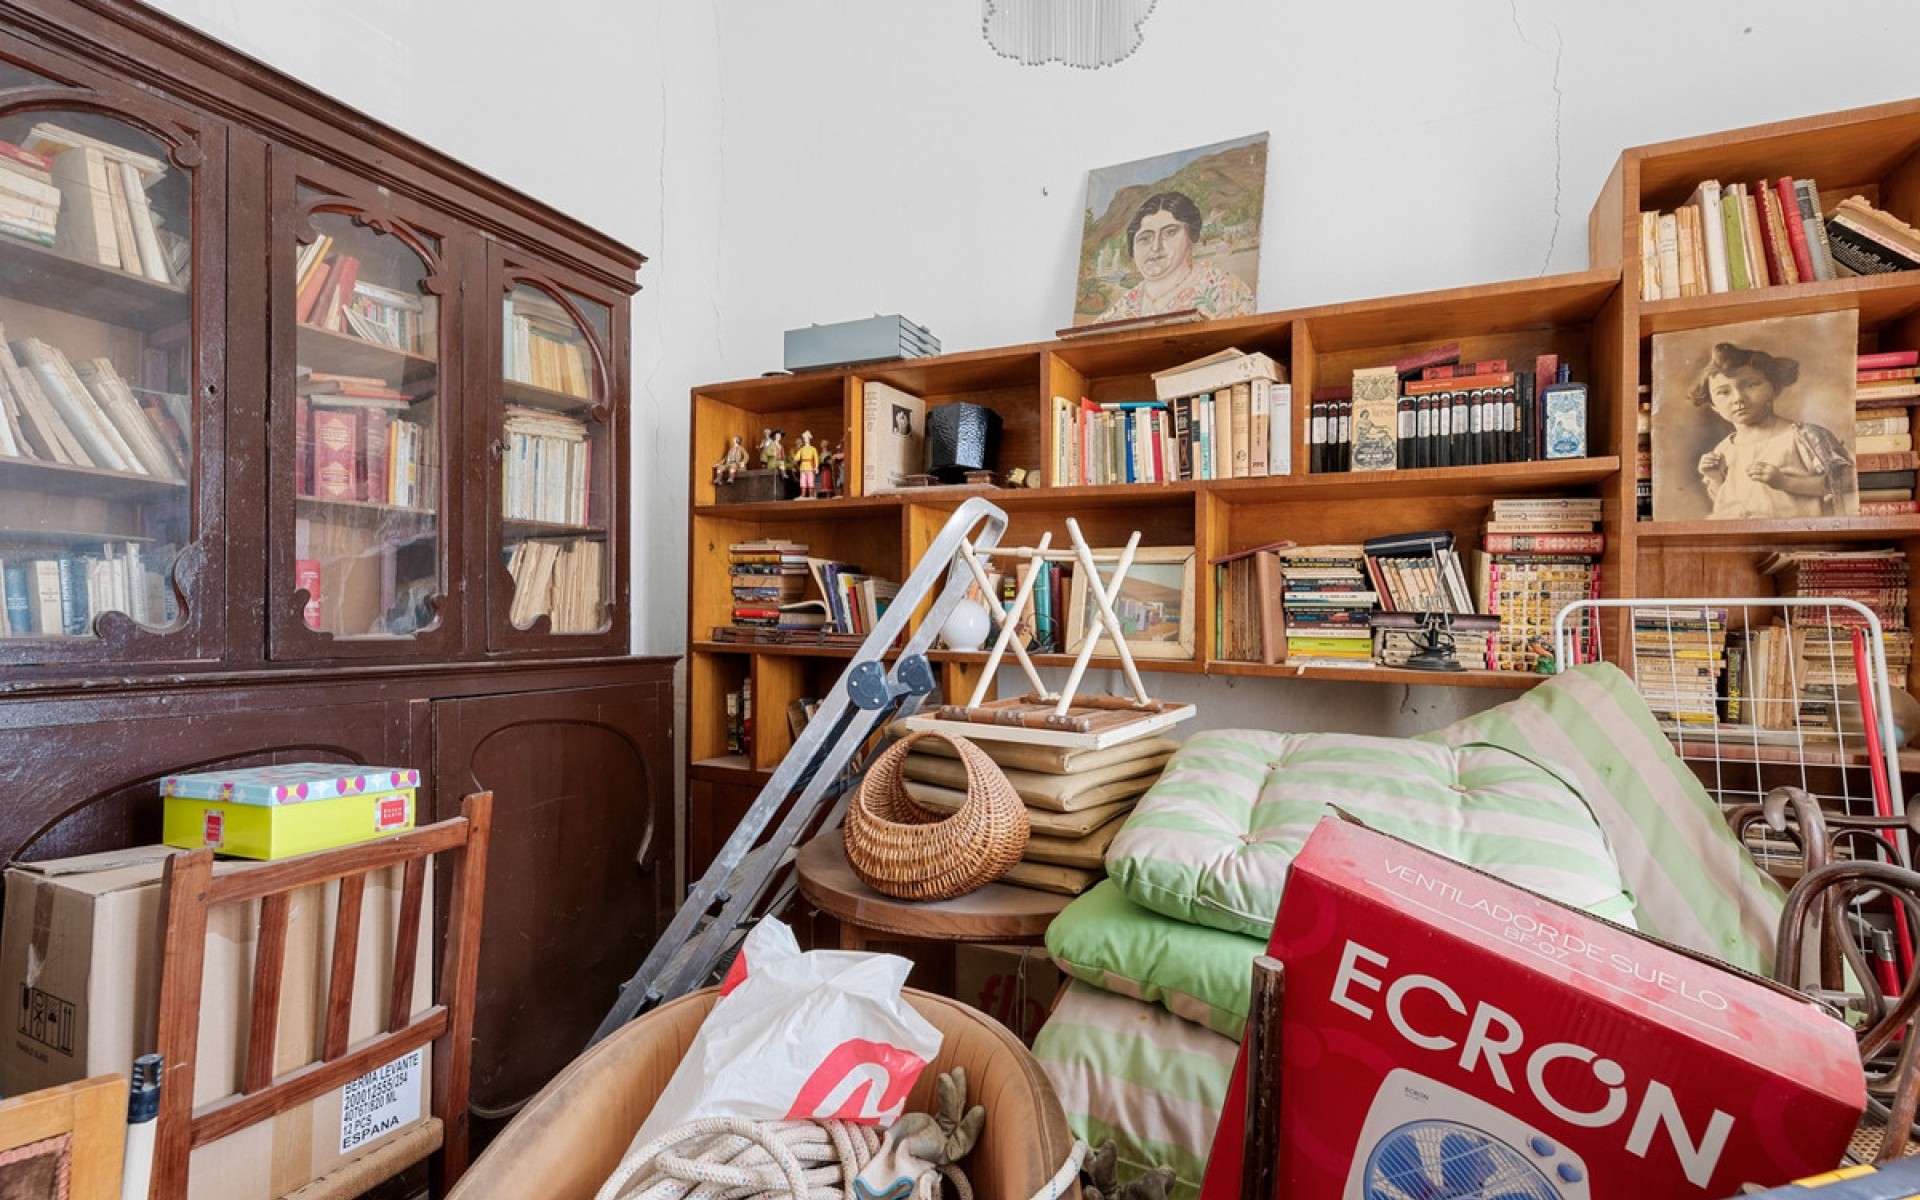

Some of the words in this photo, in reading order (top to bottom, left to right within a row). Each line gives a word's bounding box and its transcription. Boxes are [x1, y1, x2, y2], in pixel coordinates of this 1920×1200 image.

[1383, 859, 1559, 942] VENTILADOR
[1562, 935, 1605, 963] DE
[1610, 954, 1728, 1010] SUELO
[1504, 926, 1569, 959] BF-07
[381, 1053, 418, 1079] LEVANTE
[1330, 939, 1736, 1189] ECRON
[343, 1115, 399, 1149] ESPANA
[354, 1114, 372, 1131] PCS
